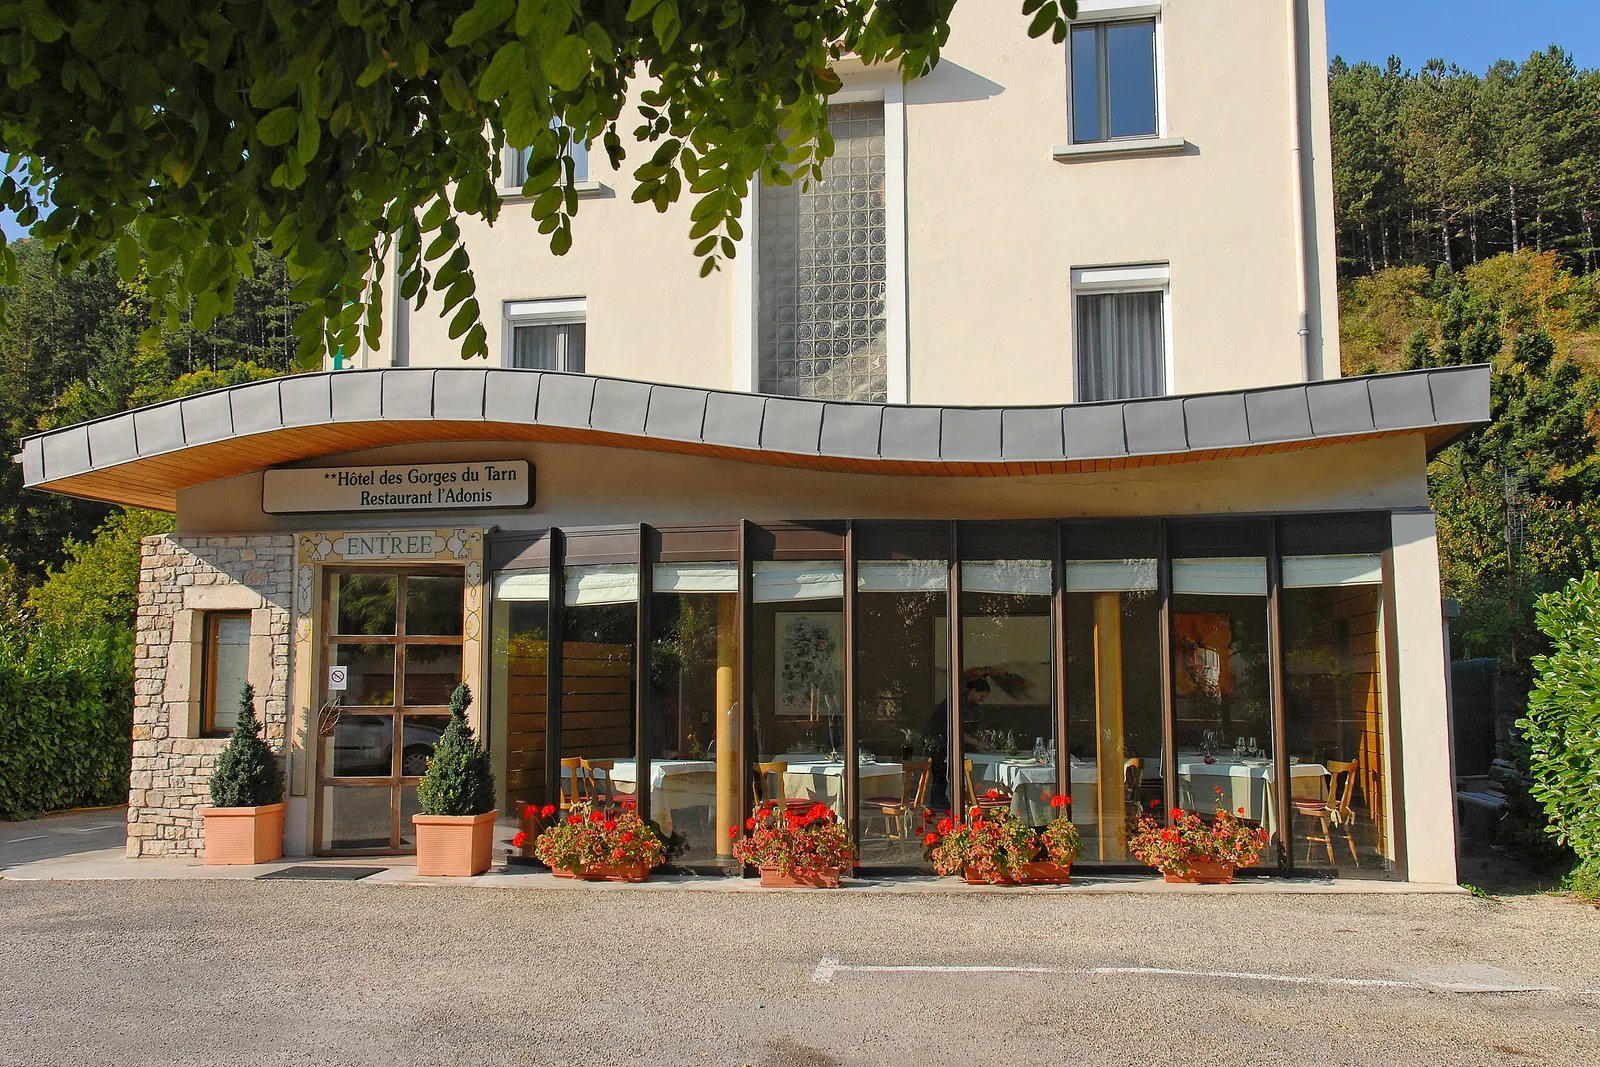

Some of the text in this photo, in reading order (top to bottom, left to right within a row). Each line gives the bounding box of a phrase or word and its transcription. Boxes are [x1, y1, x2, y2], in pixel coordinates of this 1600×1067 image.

[379, 470, 403, 485] des
[408, 468, 457, 487] Gorges
[461, 467, 480, 482] du
[485, 466, 517, 481] Tarn
[360, 490, 433, 506] Restaurant
[347, 536, 432, 555] ENTREE
